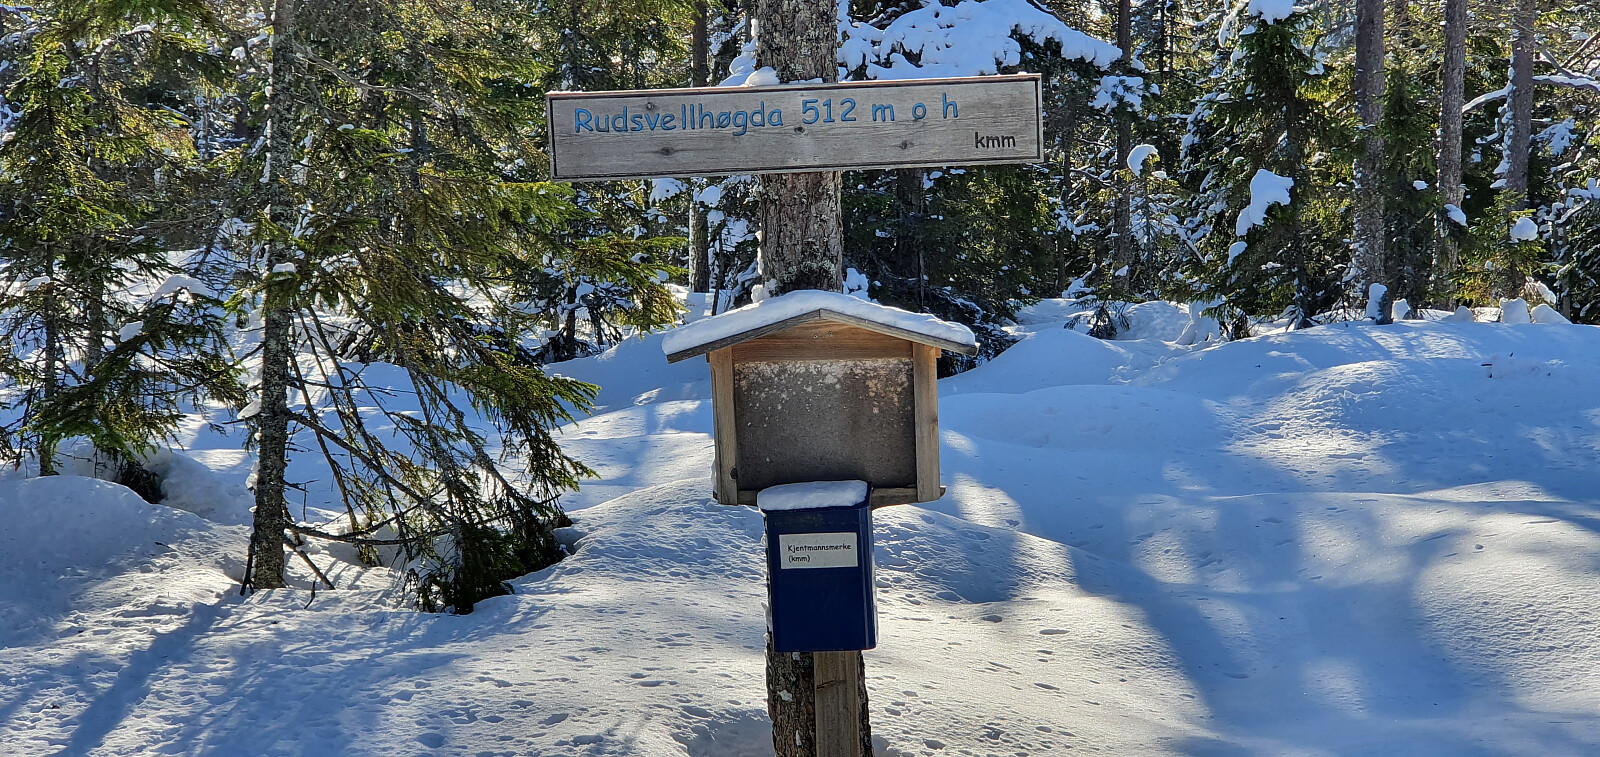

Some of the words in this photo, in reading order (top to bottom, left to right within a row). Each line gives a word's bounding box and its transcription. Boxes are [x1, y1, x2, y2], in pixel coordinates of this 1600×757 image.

[575, 101, 783, 136] Rudsvellhøgda
[801, 98, 857, 125] 512
[871, 102, 895, 122] m
[911, 101, 927, 120] o
[942, 92, 959, 119] h
[974, 131, 1016, 149] kmm
[787, 543, 852, 553] Kjentmannsmerke
[788, 554, 811, 563] (kmm)
